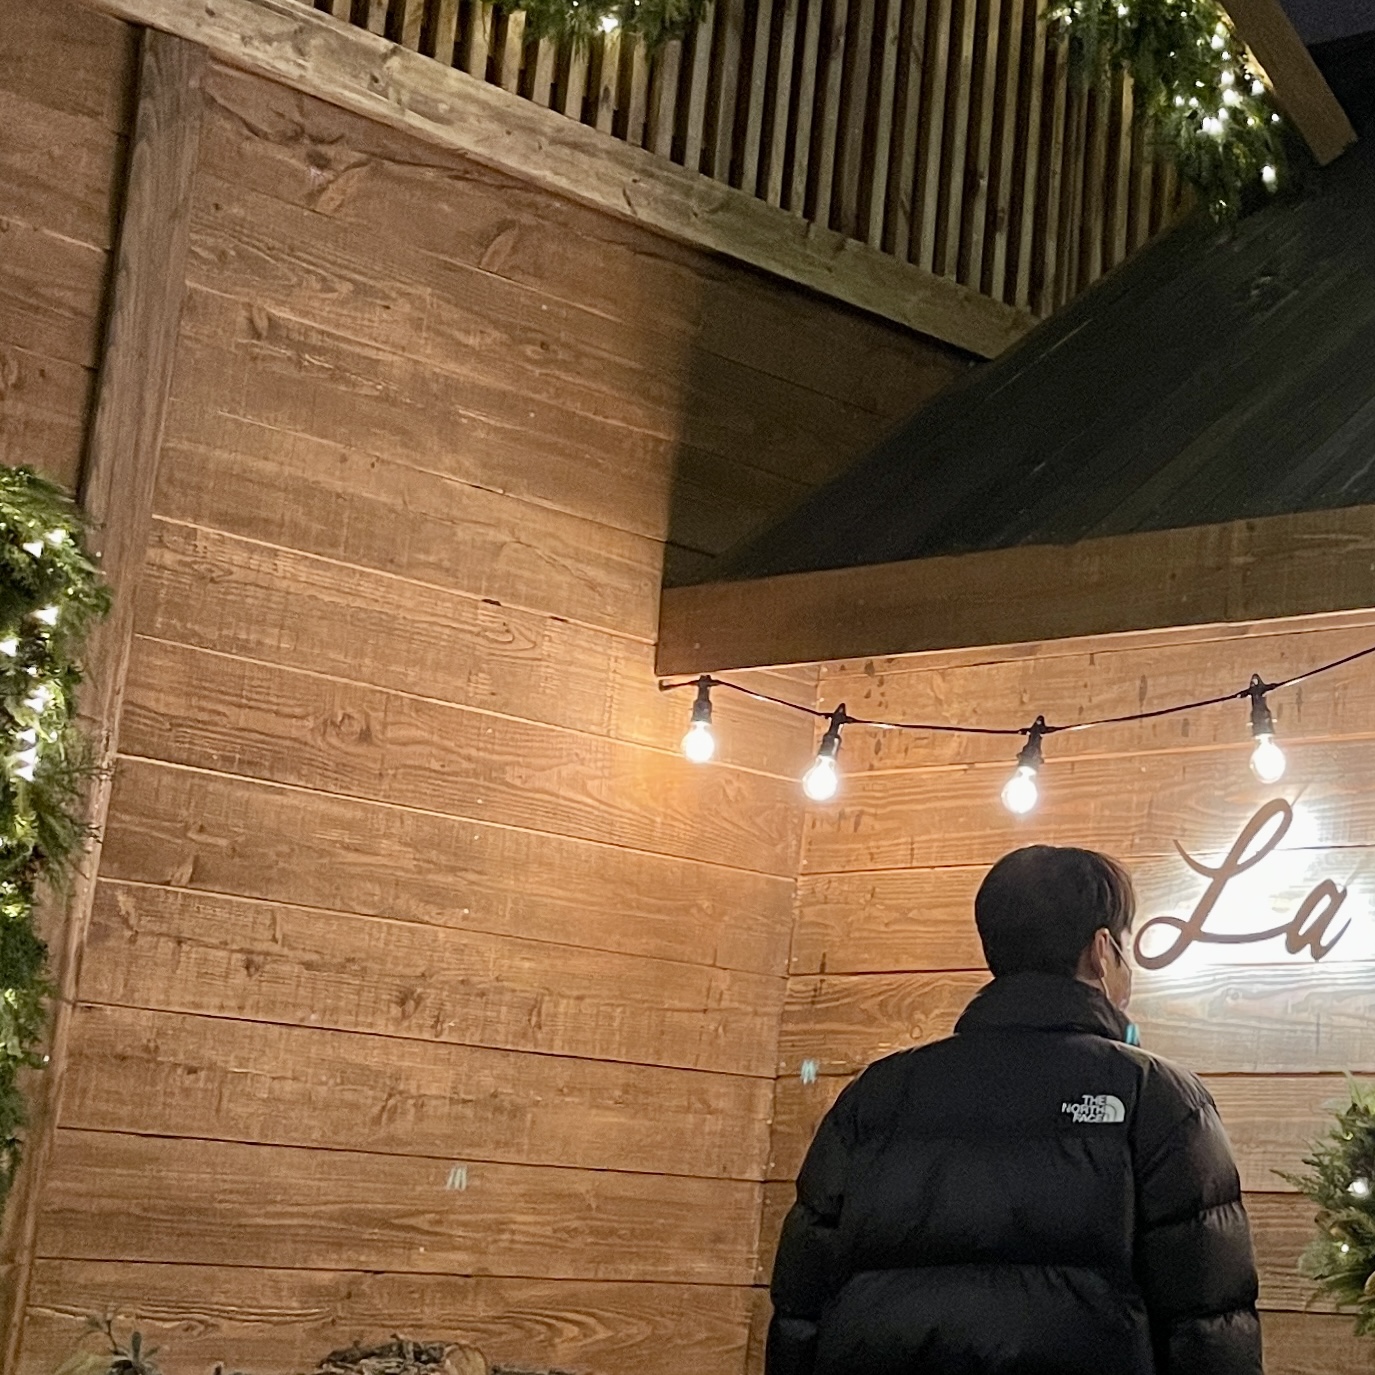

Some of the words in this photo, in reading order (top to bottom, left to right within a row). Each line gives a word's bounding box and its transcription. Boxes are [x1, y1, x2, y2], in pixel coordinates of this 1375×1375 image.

[1134, 798, 1352, 971] La
[1082, 1095, 1106, 1105] THE
[1061, 1103, 1106, 1114] NORTH
[1073, 1113, 1105, 1123] FACE
